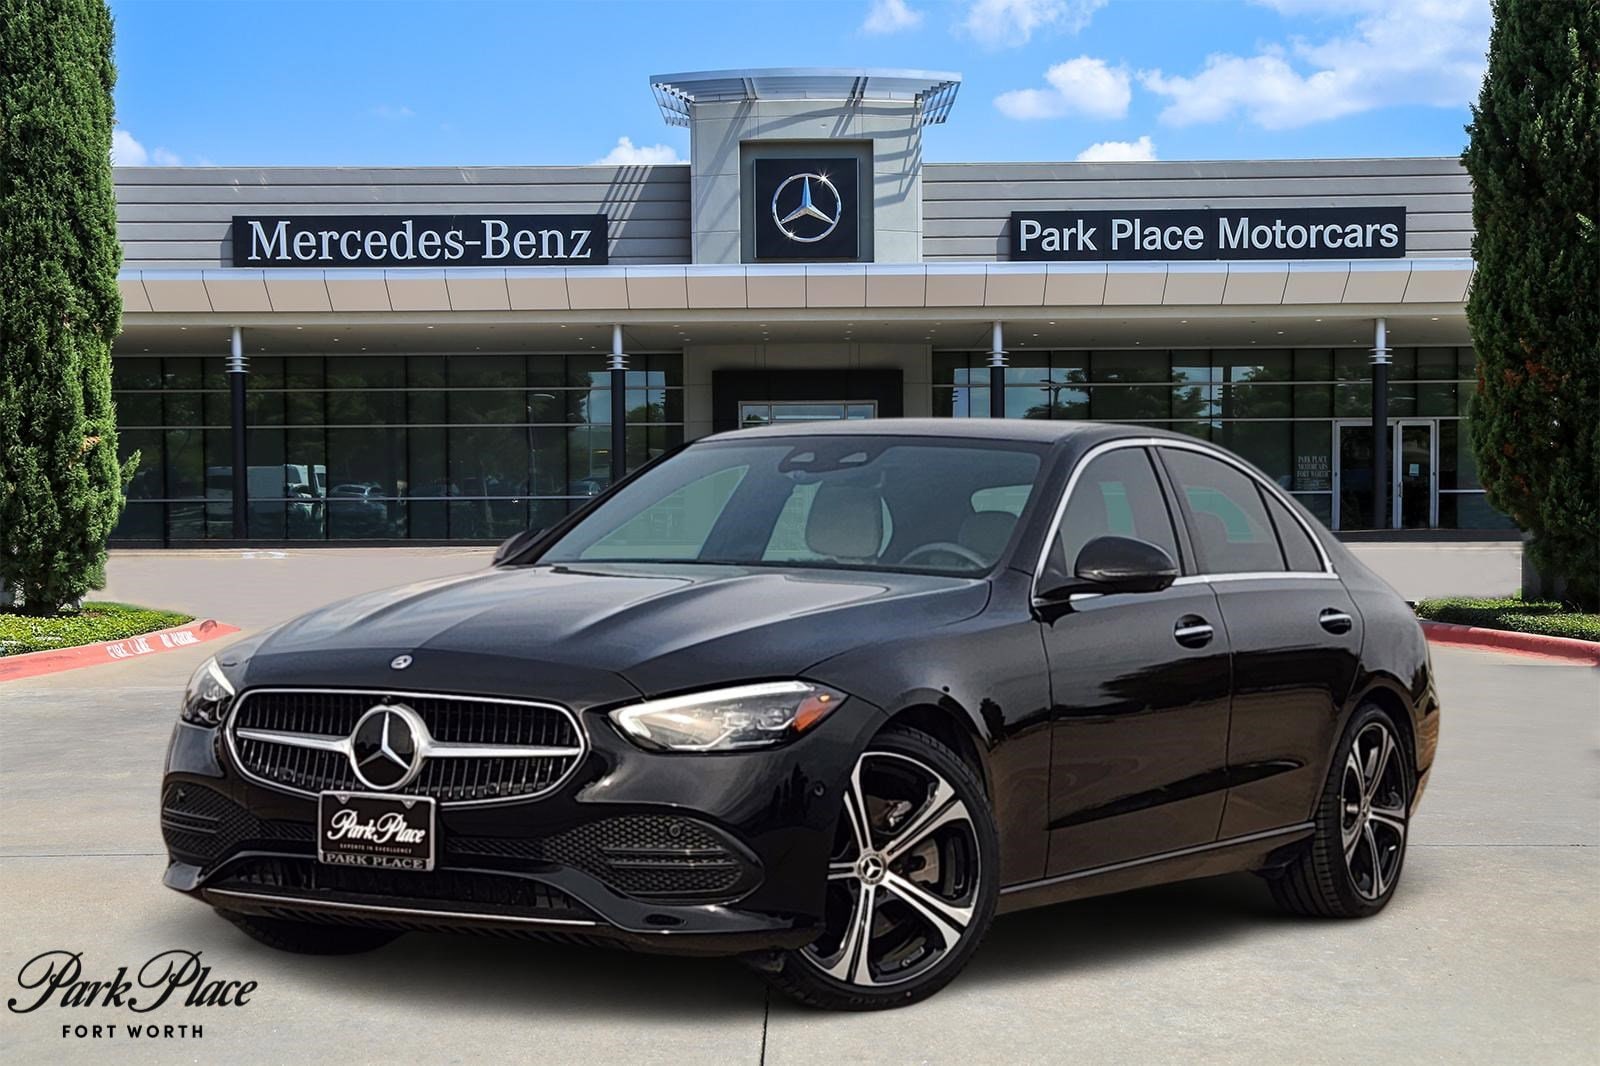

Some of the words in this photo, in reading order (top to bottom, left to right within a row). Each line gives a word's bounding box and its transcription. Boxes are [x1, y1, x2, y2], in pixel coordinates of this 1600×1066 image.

[247, 219, 592, 260] Mercedes-Benz
[1019, 219, 1097, 251] Park
[1110, 218, 1204, 251] Place
[1218, 216, 1399, 250] Motorcars
[327, 809, 376, 840] Park
[372, 812, 426, 844] Place
[325, 853, 368, 866] PARK
[373, 856, 424, 869] PLACE
